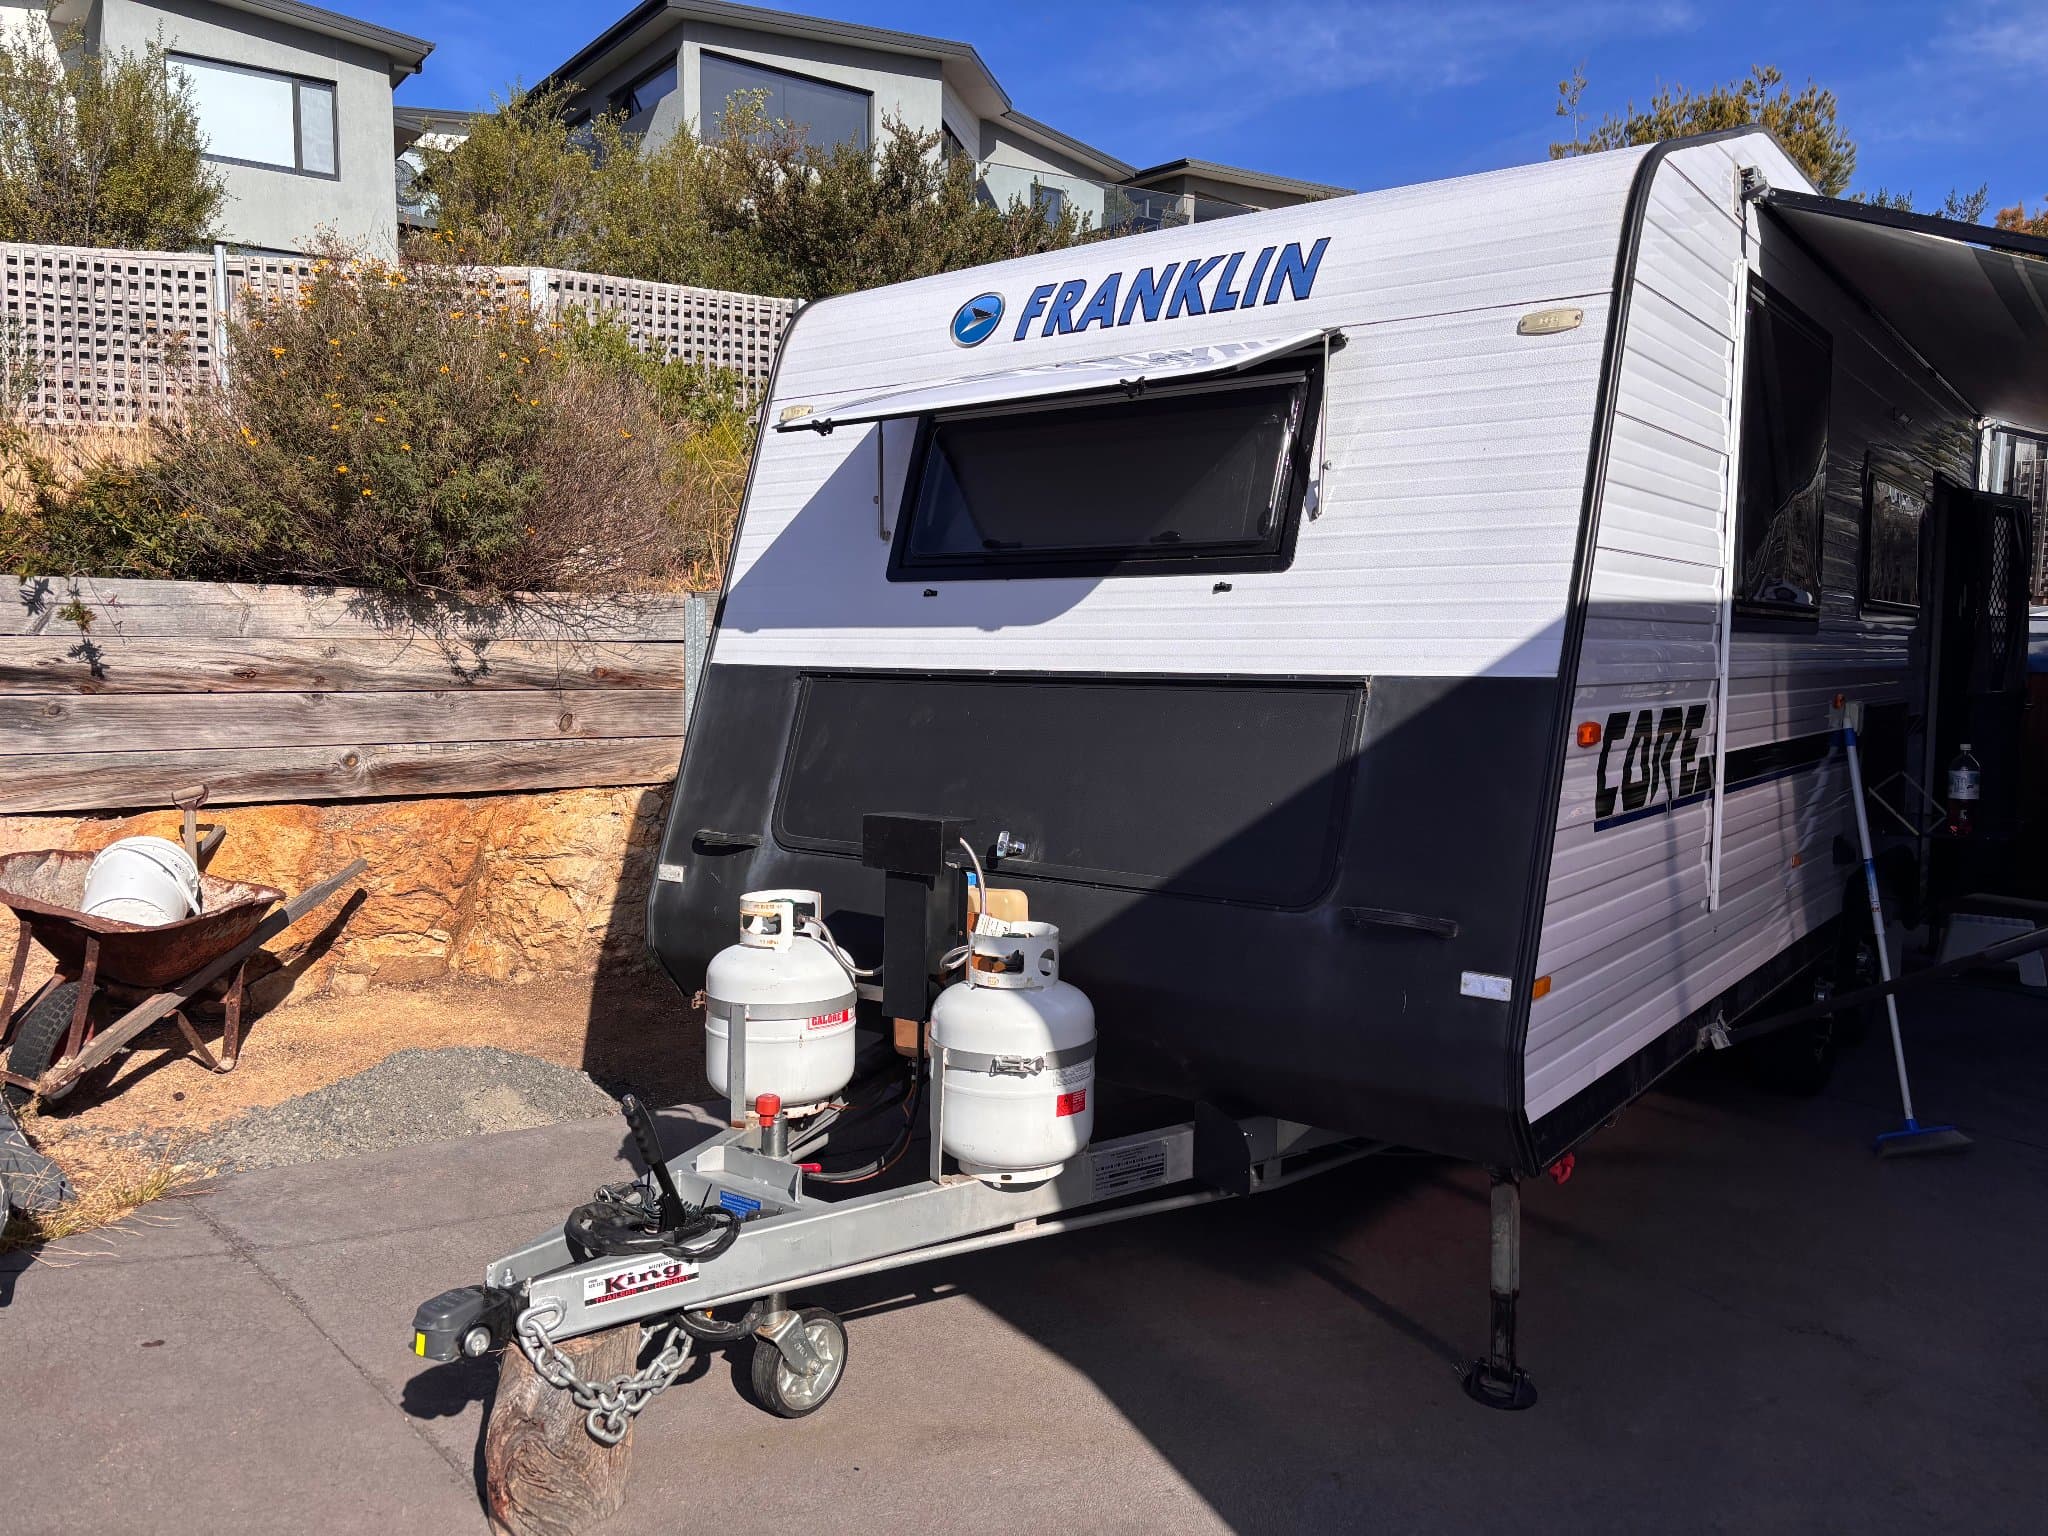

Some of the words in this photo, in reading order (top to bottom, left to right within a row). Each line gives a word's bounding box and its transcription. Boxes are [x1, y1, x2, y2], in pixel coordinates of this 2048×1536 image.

[1013, 237, 1332, 341] FRANKLIN
[1595, 704, 1707, 819] CORE
[603, 1263, 683, 1295] King
